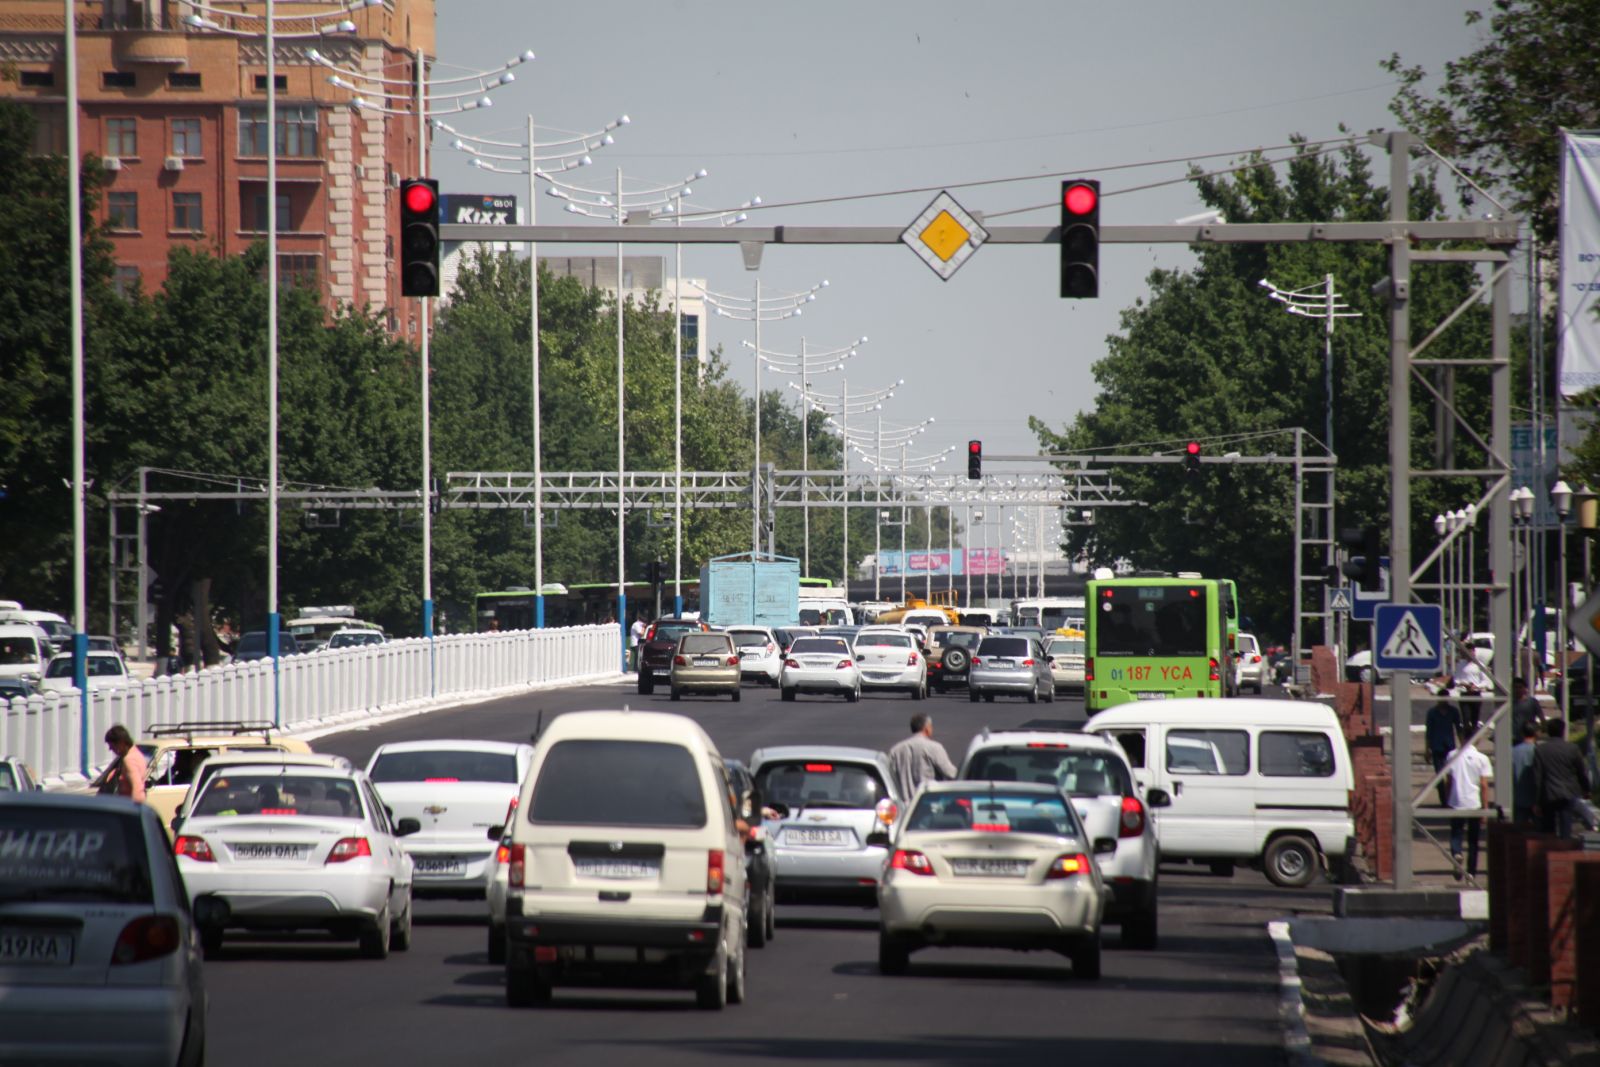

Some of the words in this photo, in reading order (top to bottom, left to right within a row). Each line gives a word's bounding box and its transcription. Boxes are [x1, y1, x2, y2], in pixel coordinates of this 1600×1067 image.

[457, 206, 508, 224] Kixx
[1111, 669, 1122, 680] 01
[1126, 666, 1152, 681] 187
[1160, 666, 1192, 681] YCA
[0, 830, 106, 859] ИПАР
[0, 936, 58, 957] 19RA
